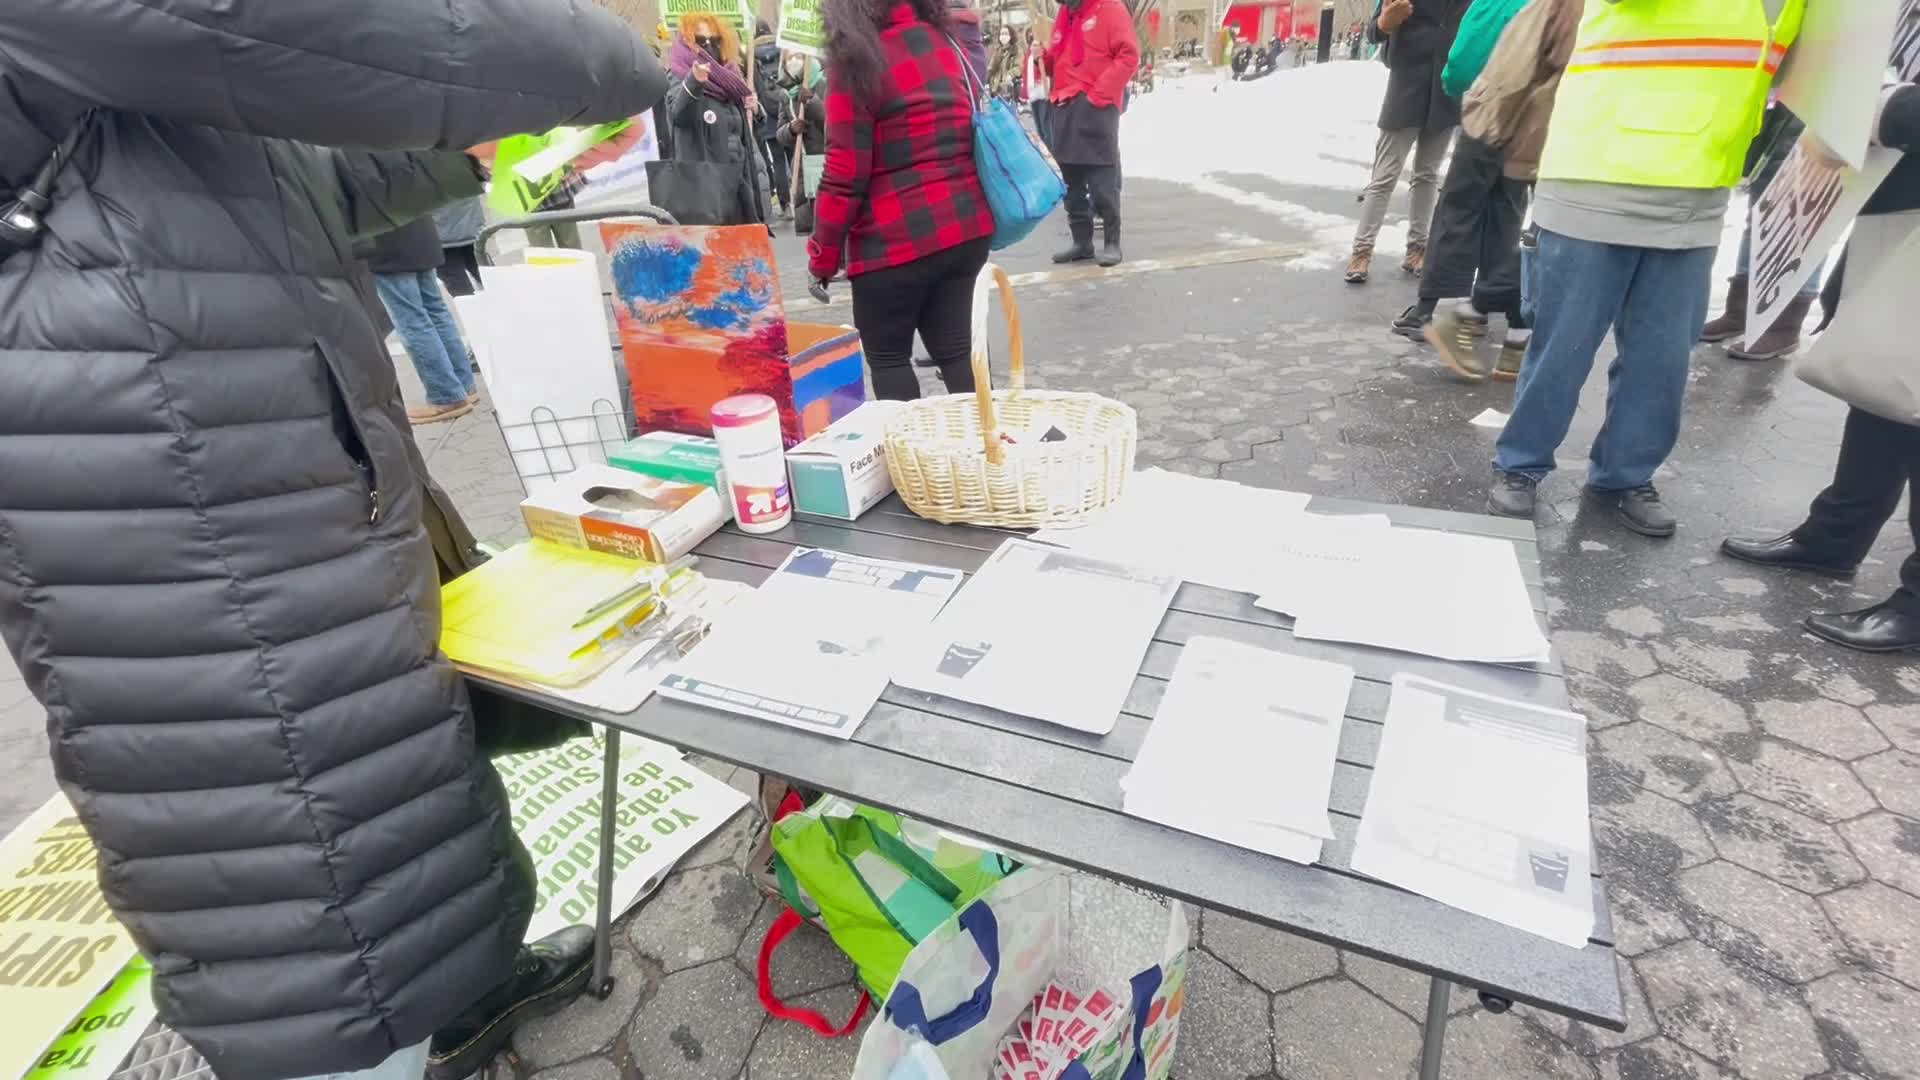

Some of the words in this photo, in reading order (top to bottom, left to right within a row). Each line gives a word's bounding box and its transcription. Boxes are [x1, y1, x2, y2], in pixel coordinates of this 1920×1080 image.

[849, 454, 873, 474] Face
[623, 761, 664, 787] de
[651, 808, 700, 835] Yo
[559, 834, 652, 923] apyo
